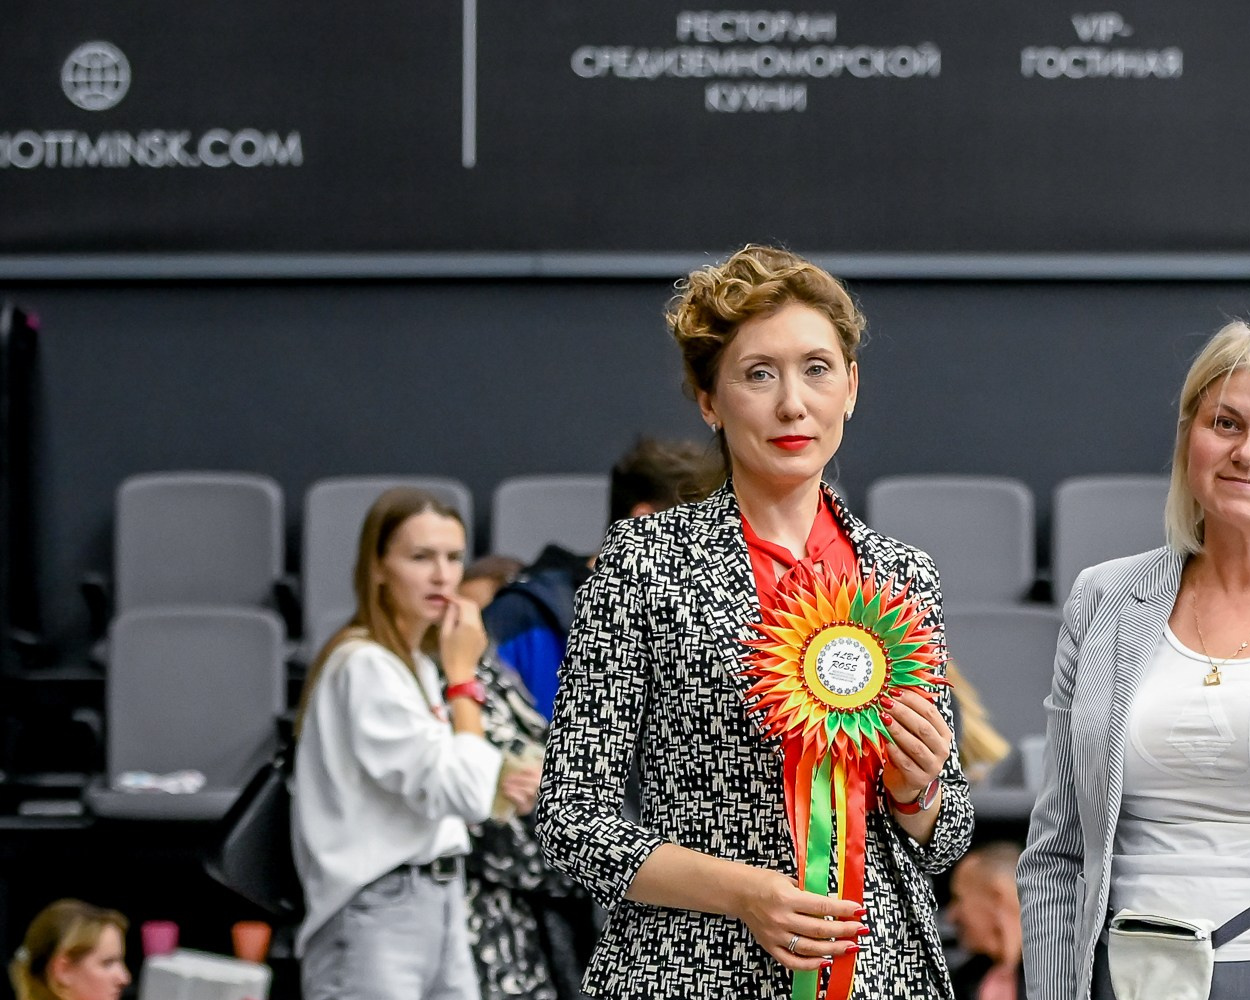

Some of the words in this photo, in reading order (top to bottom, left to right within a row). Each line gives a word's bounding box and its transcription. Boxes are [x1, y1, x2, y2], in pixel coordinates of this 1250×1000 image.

[677, 10, 837, 43] РЕСТОРАН
[571, 41, 941, 79] СРЕДИЗЕМНОМОРСКОЙ
[1020, 46, 1183, 79] ГОСТИНАЯ
[705, 82, 807, 113] КУХНИ
[828, 660, 858, 672] ROSS
[832, 650, 861, 662] ALBA
